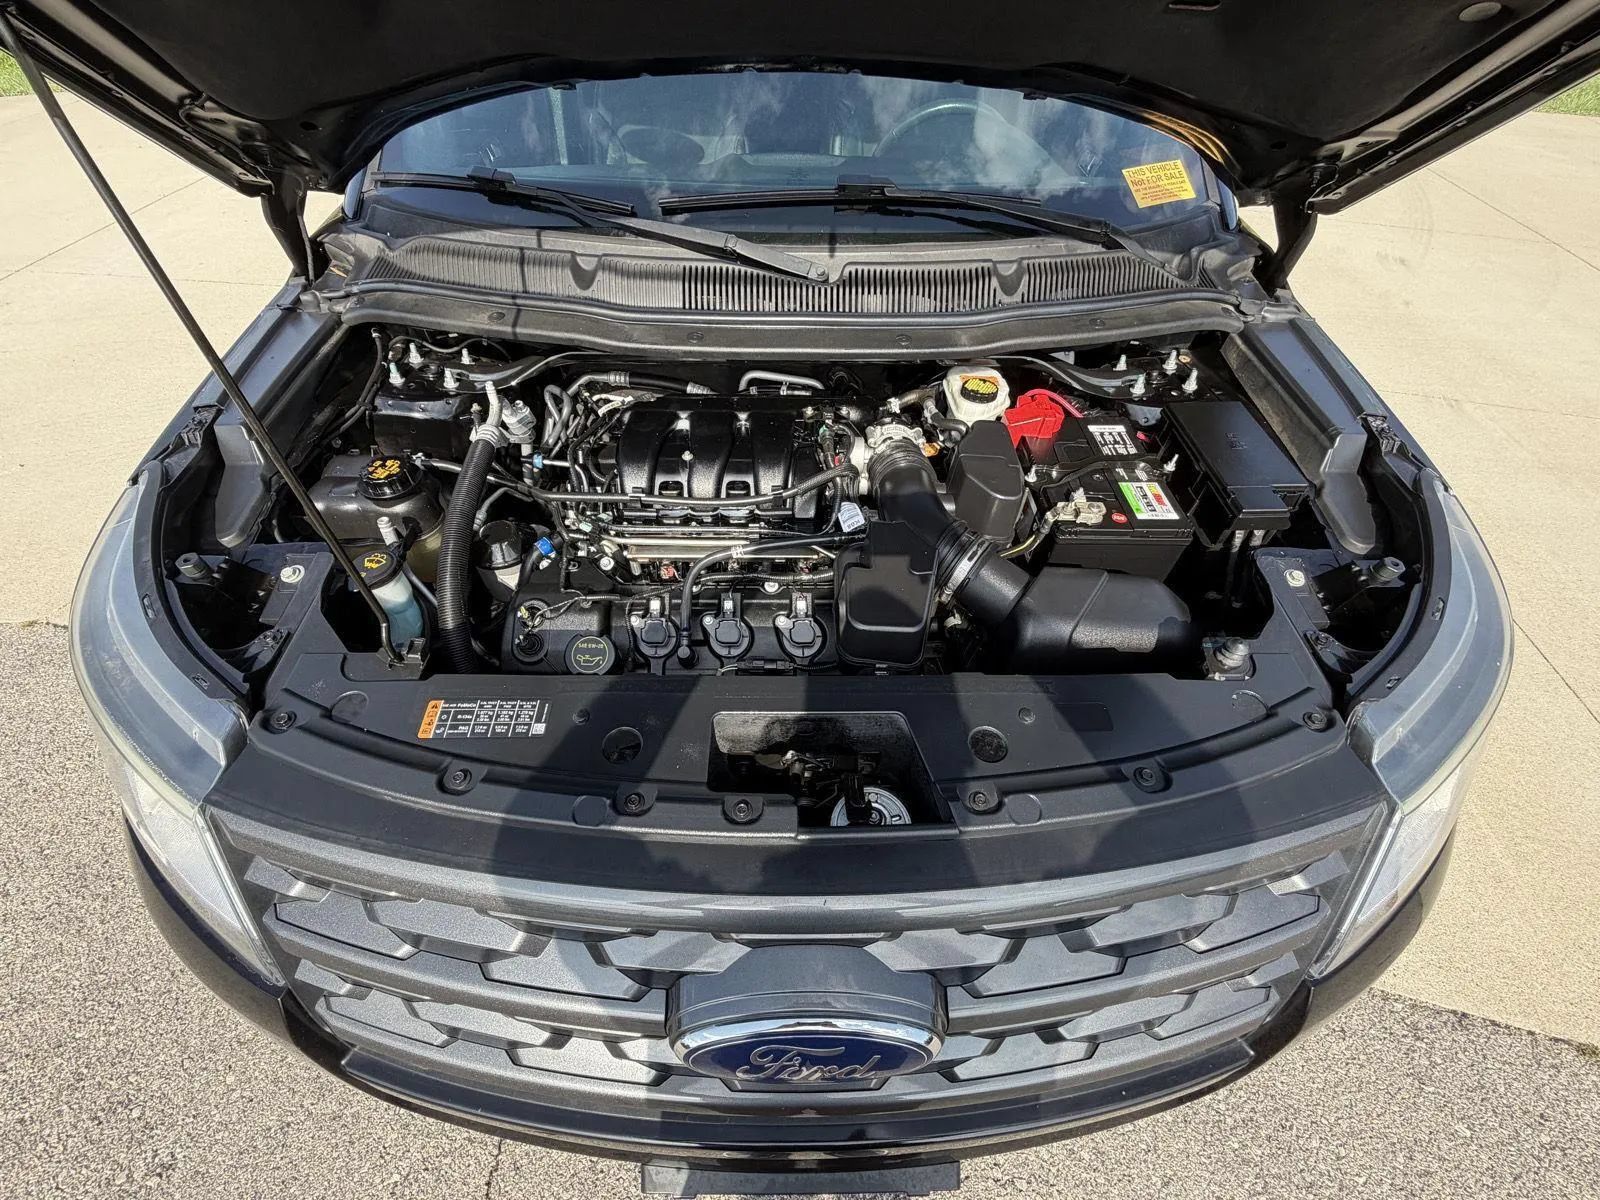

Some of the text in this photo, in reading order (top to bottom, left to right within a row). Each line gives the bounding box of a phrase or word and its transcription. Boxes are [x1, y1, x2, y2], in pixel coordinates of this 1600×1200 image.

[1126, 161, 1180, 178] THIS VEHICLE
[1146, 175, 1164, 185] FOR
[1163, 170, 1185, 181] SALE
[736, 1044, 881, 1081] Ford
